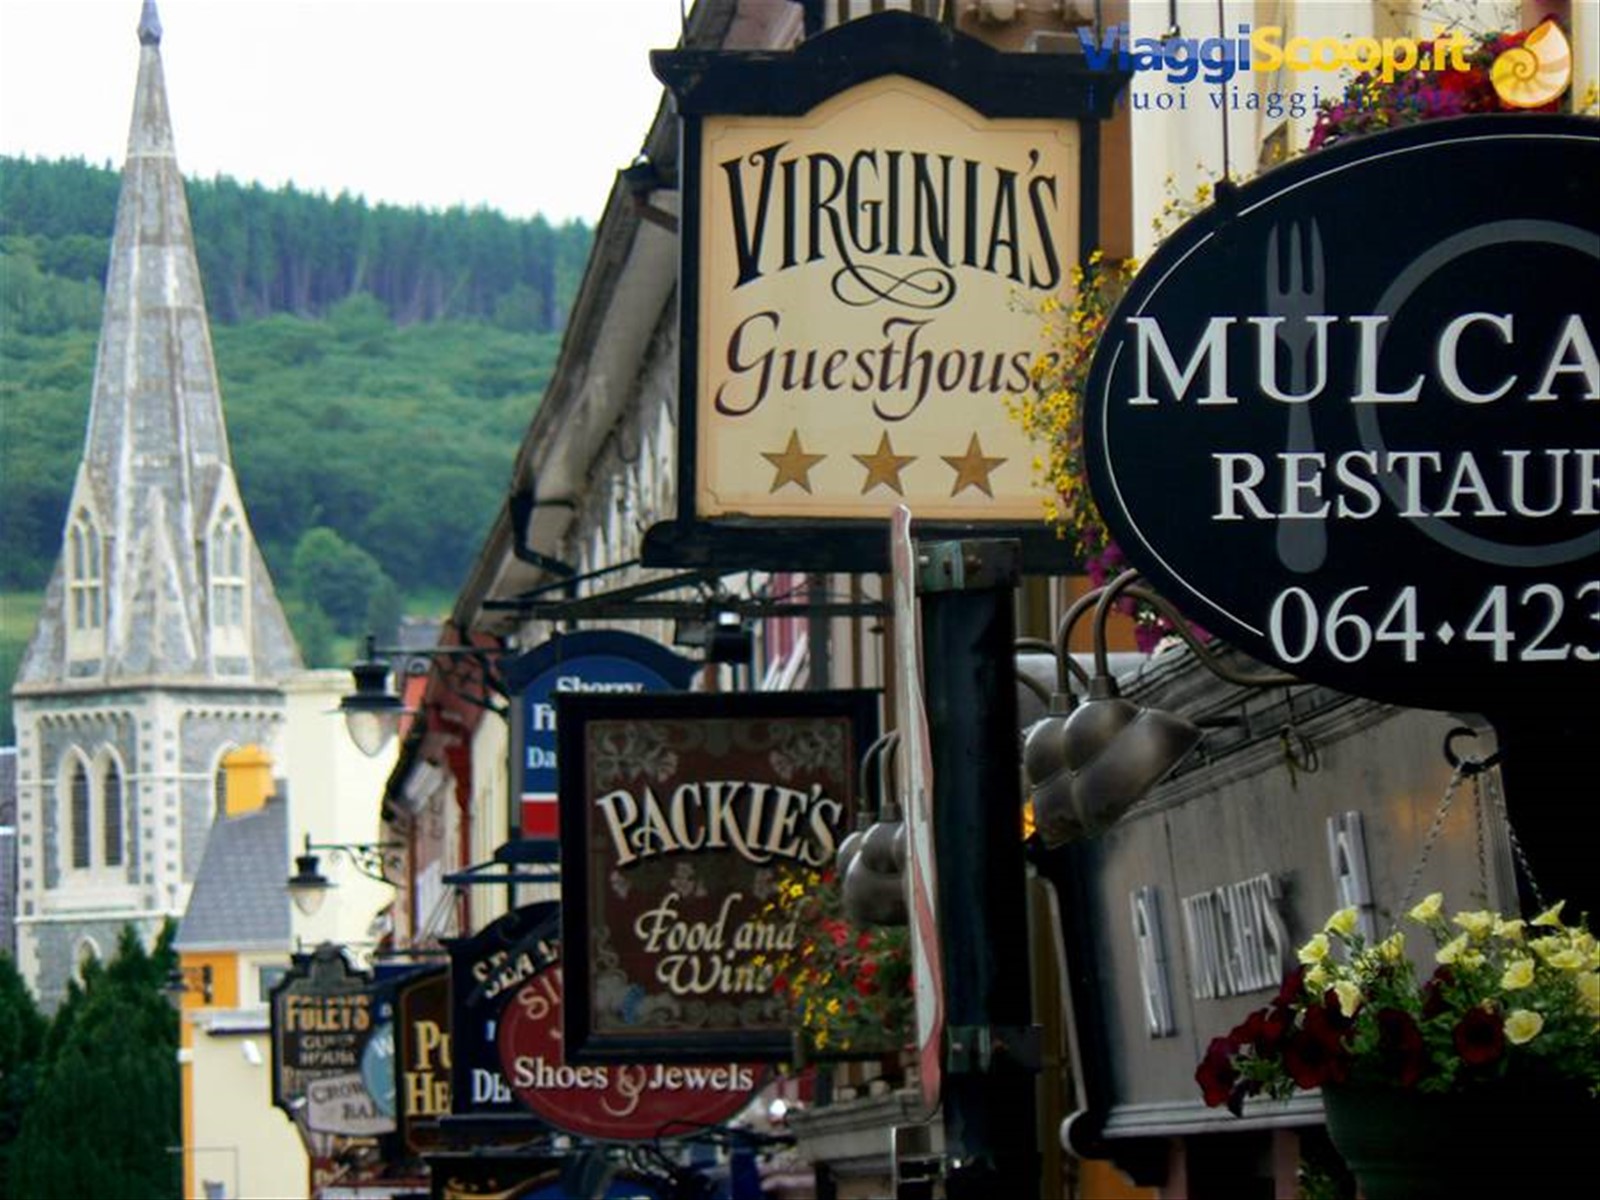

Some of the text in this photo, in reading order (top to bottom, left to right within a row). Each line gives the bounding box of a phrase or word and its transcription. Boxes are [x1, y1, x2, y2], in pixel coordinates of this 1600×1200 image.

[720, 140, 1061, 309] VIRGINIA'S
[1127, 312, 1600, 405] MULCA
[596, 780, 843, 867] PACKIE'S
[635, 892, 742, 952] Food
[513, 1056, 609, 1089] Shoes
[648, 1063, 754, 1091] Jewels
